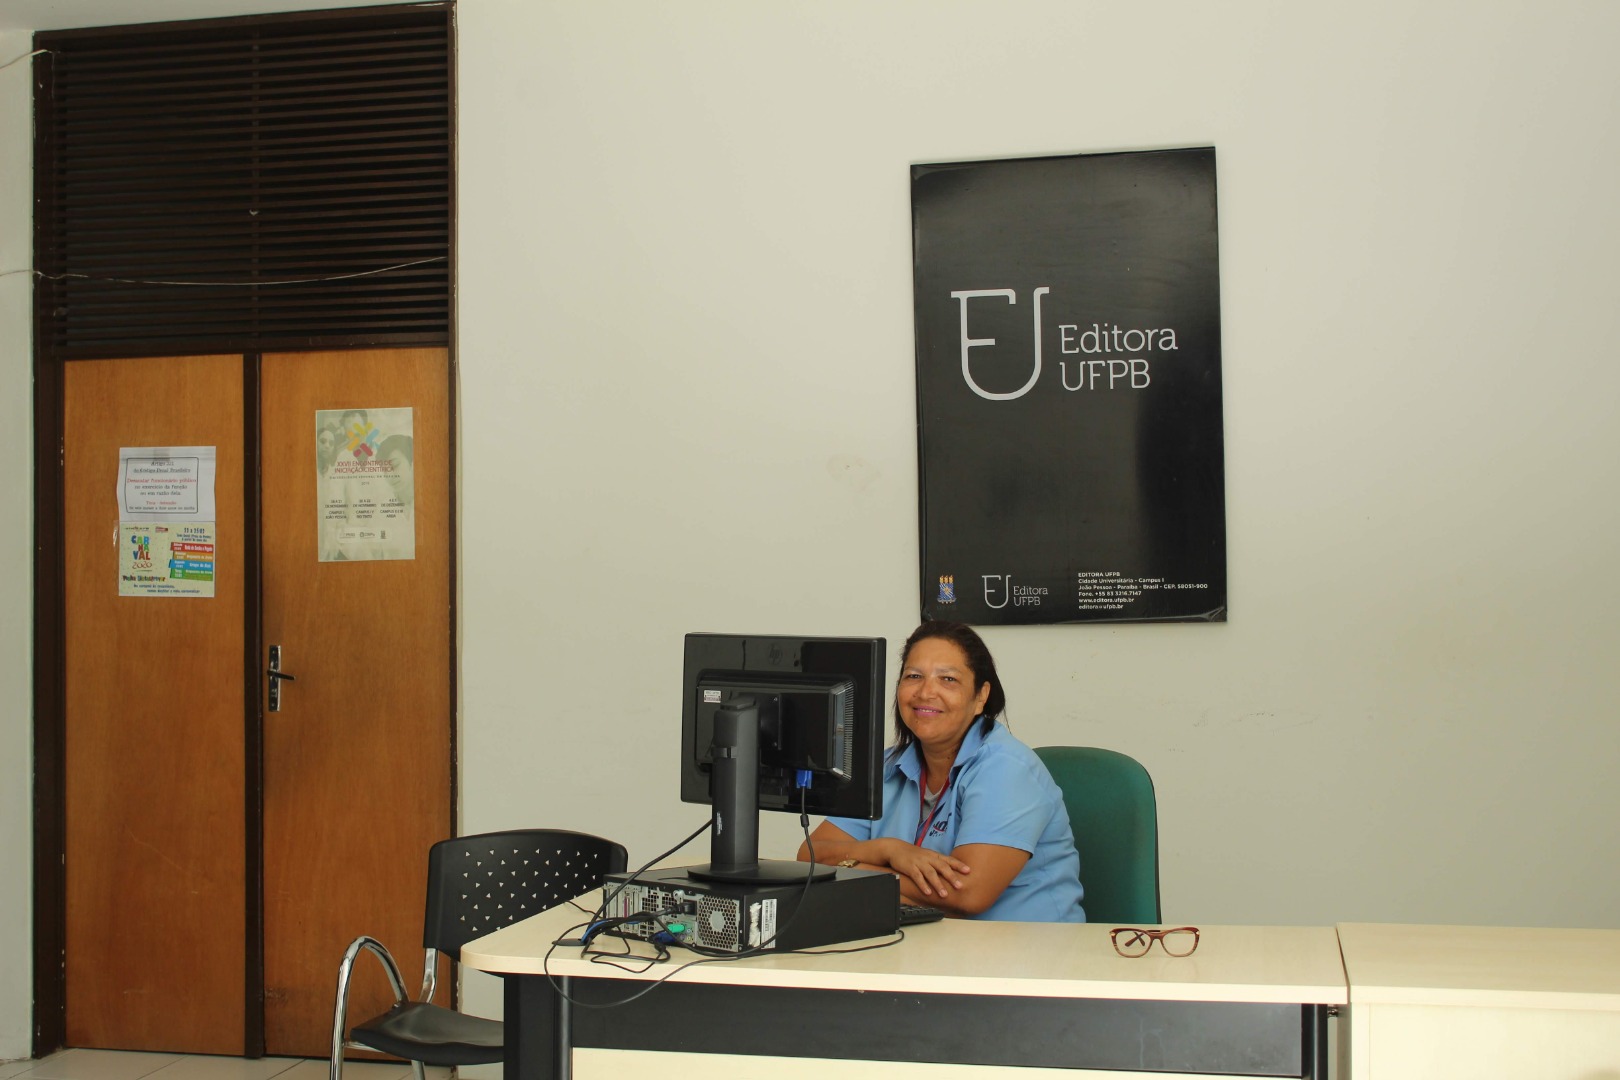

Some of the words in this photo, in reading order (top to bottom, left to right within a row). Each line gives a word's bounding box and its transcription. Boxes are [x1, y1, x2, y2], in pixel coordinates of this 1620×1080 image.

[1059, 323, 1178, 354] Editora
[1059, 359, 1150, 391] UFPB
[132, 561, 153, 570] 2020
[1013, 586, 1049, 596] Editora
[1013, 597, 1041, 606] UFPB
